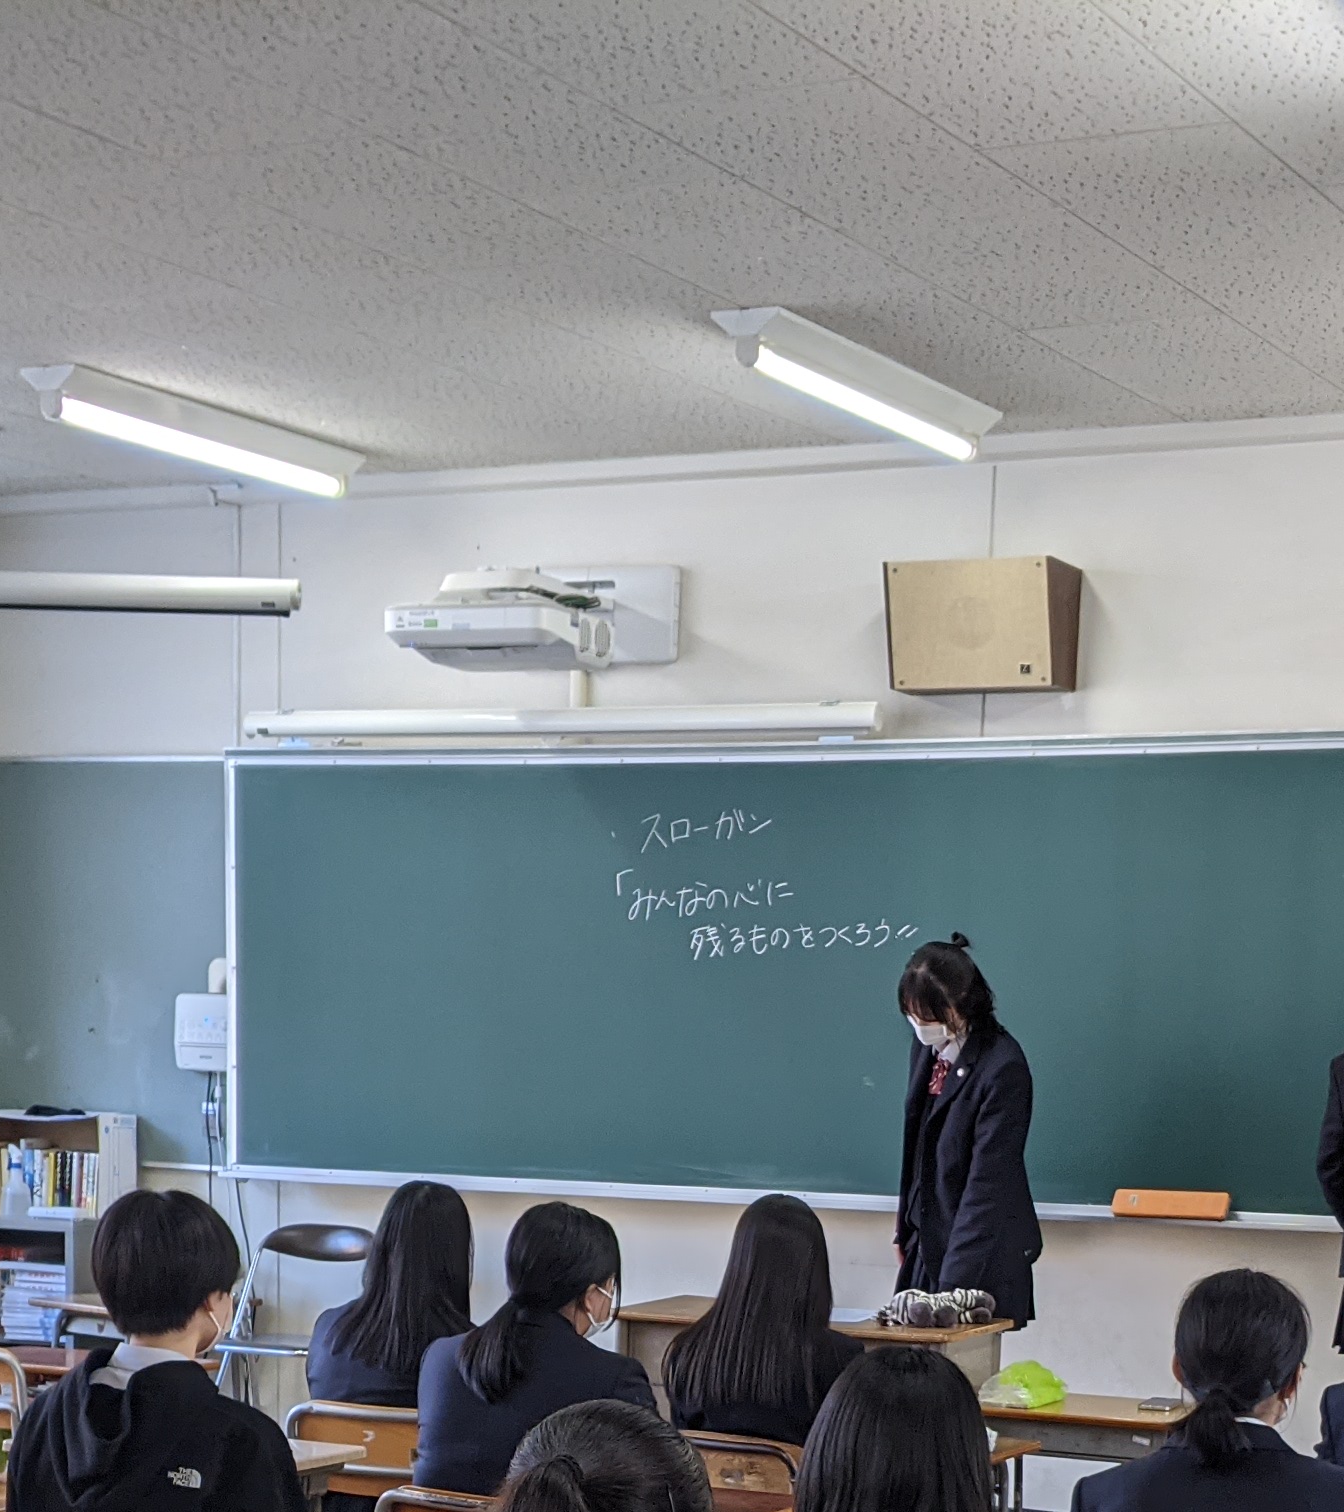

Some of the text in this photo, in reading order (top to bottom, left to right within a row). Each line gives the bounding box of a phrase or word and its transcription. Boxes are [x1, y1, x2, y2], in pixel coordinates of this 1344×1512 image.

[614, 869, 794, 921] 「みんなの心に
